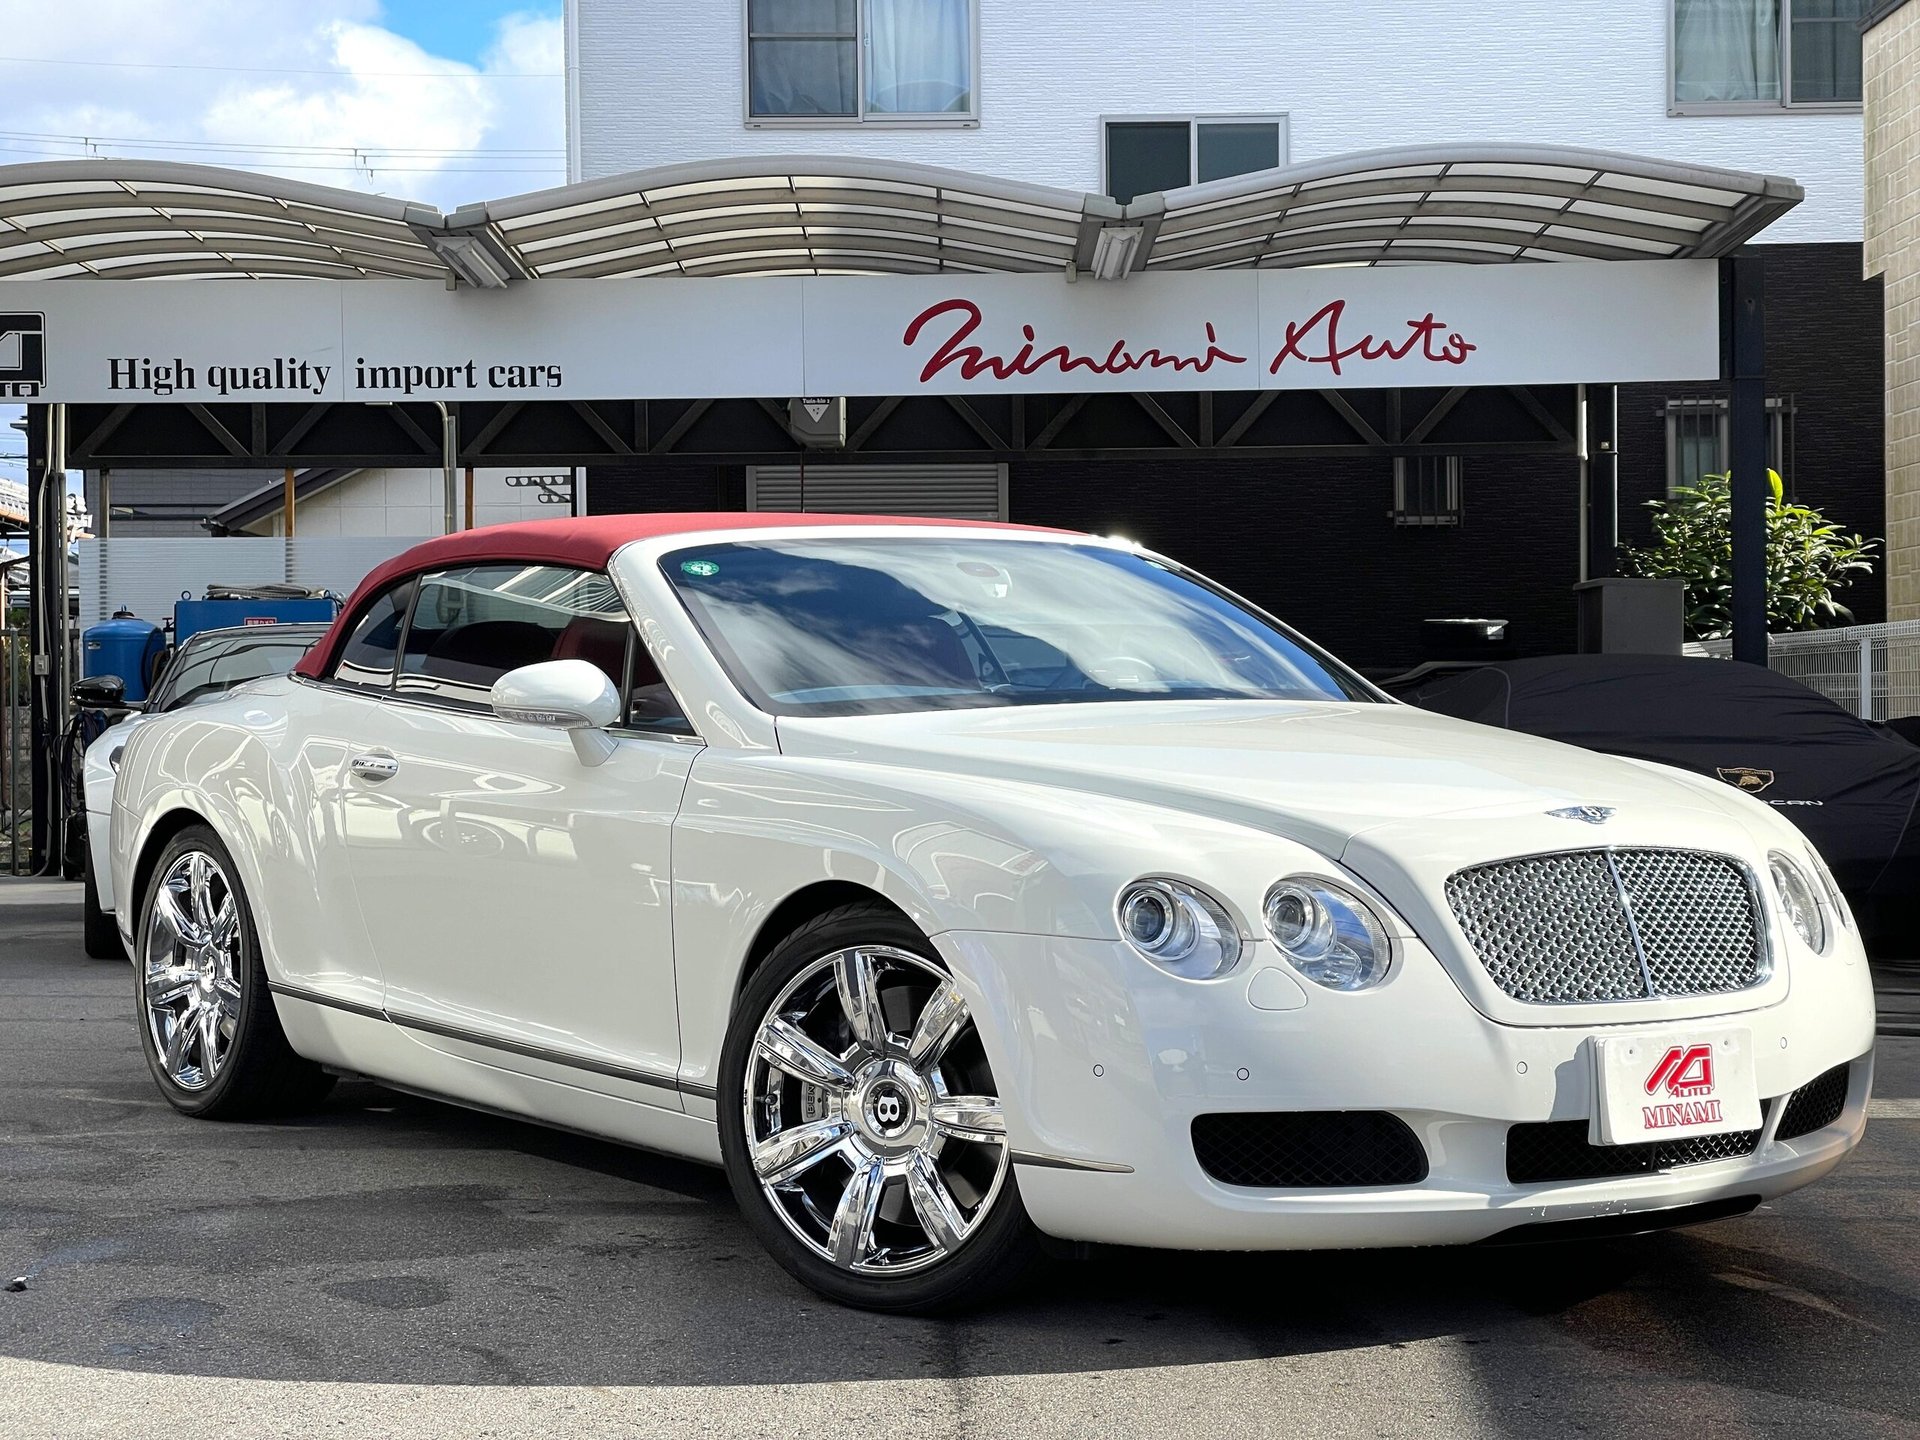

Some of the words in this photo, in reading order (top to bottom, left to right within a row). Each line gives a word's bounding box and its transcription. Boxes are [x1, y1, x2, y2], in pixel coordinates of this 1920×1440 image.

[903, 299, 1247, 382] Minami
[1270, 300, 1477, 375] Auto
[107, 358, 197, 395] High
[207, 358, 331, 395] quality
[355, 358, 477, 394] import
[488, 366, 562, 388] cars
[1642, 1100, 1723, 1129] MINAMI
